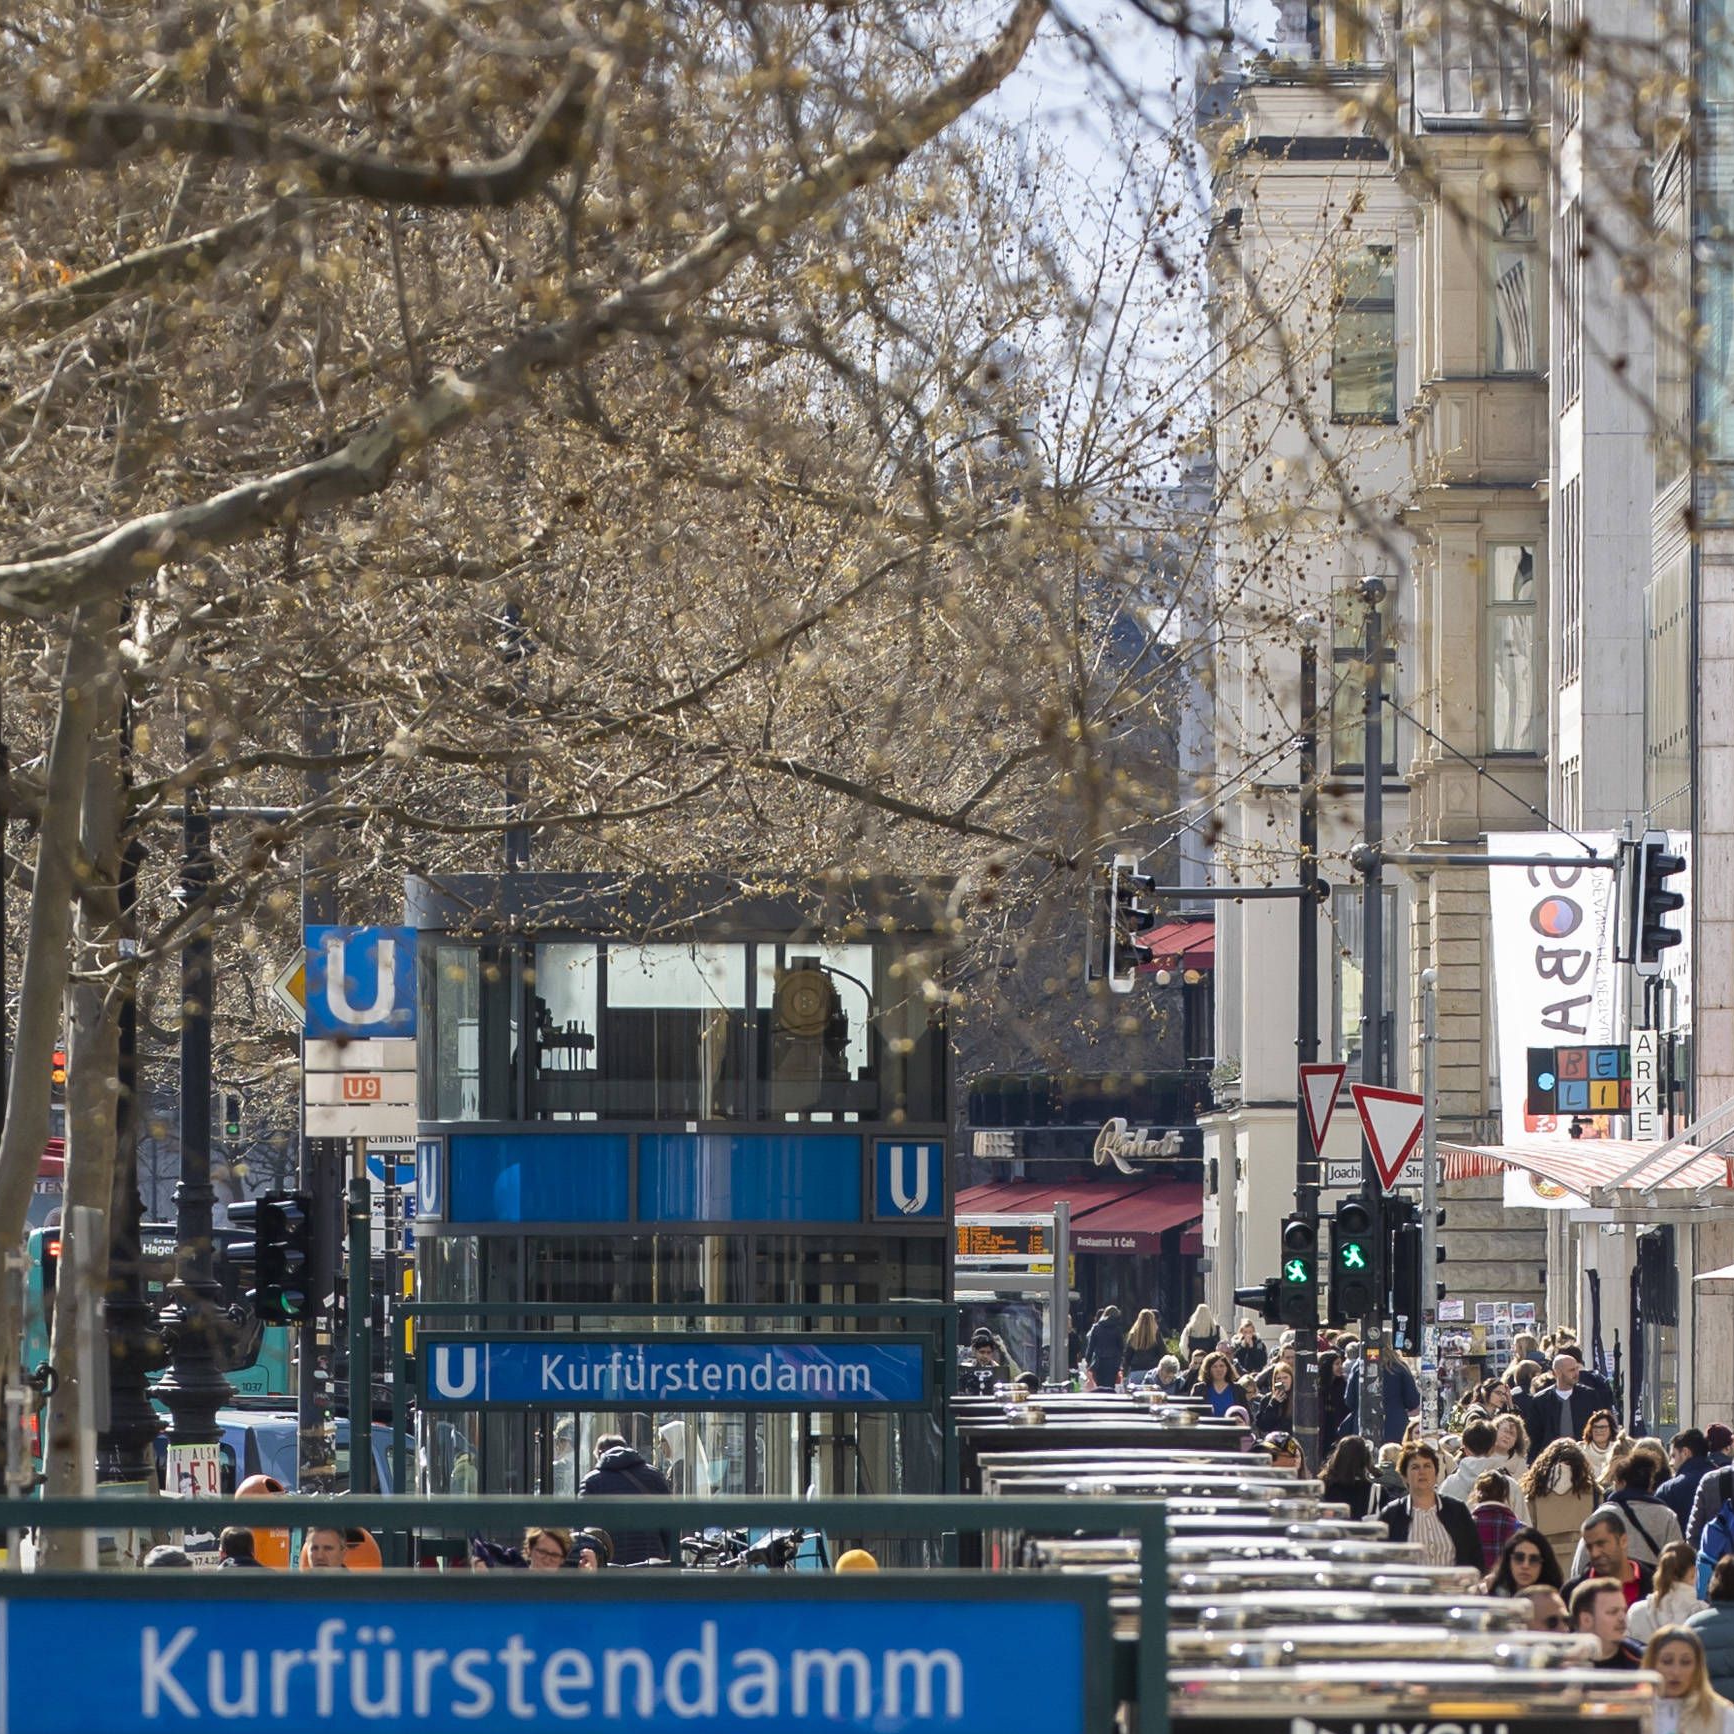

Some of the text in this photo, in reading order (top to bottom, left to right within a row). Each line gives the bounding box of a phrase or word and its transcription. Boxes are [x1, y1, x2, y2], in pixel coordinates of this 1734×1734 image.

[327, 938, 396, 1025] U
[347, 1078, 378, 1098] U9
[1636, 1034, 1653, 1142] ARKE
[421, 1144, 437, 1213] U
[890, 1146, 930, 1214] U
[1329, 1166, 1361, 1181] Joachi
[436, 1346, 872, 1399] U Kurfürstendamm
[140, 1617, 965, 1723] Kurfürstendamm
